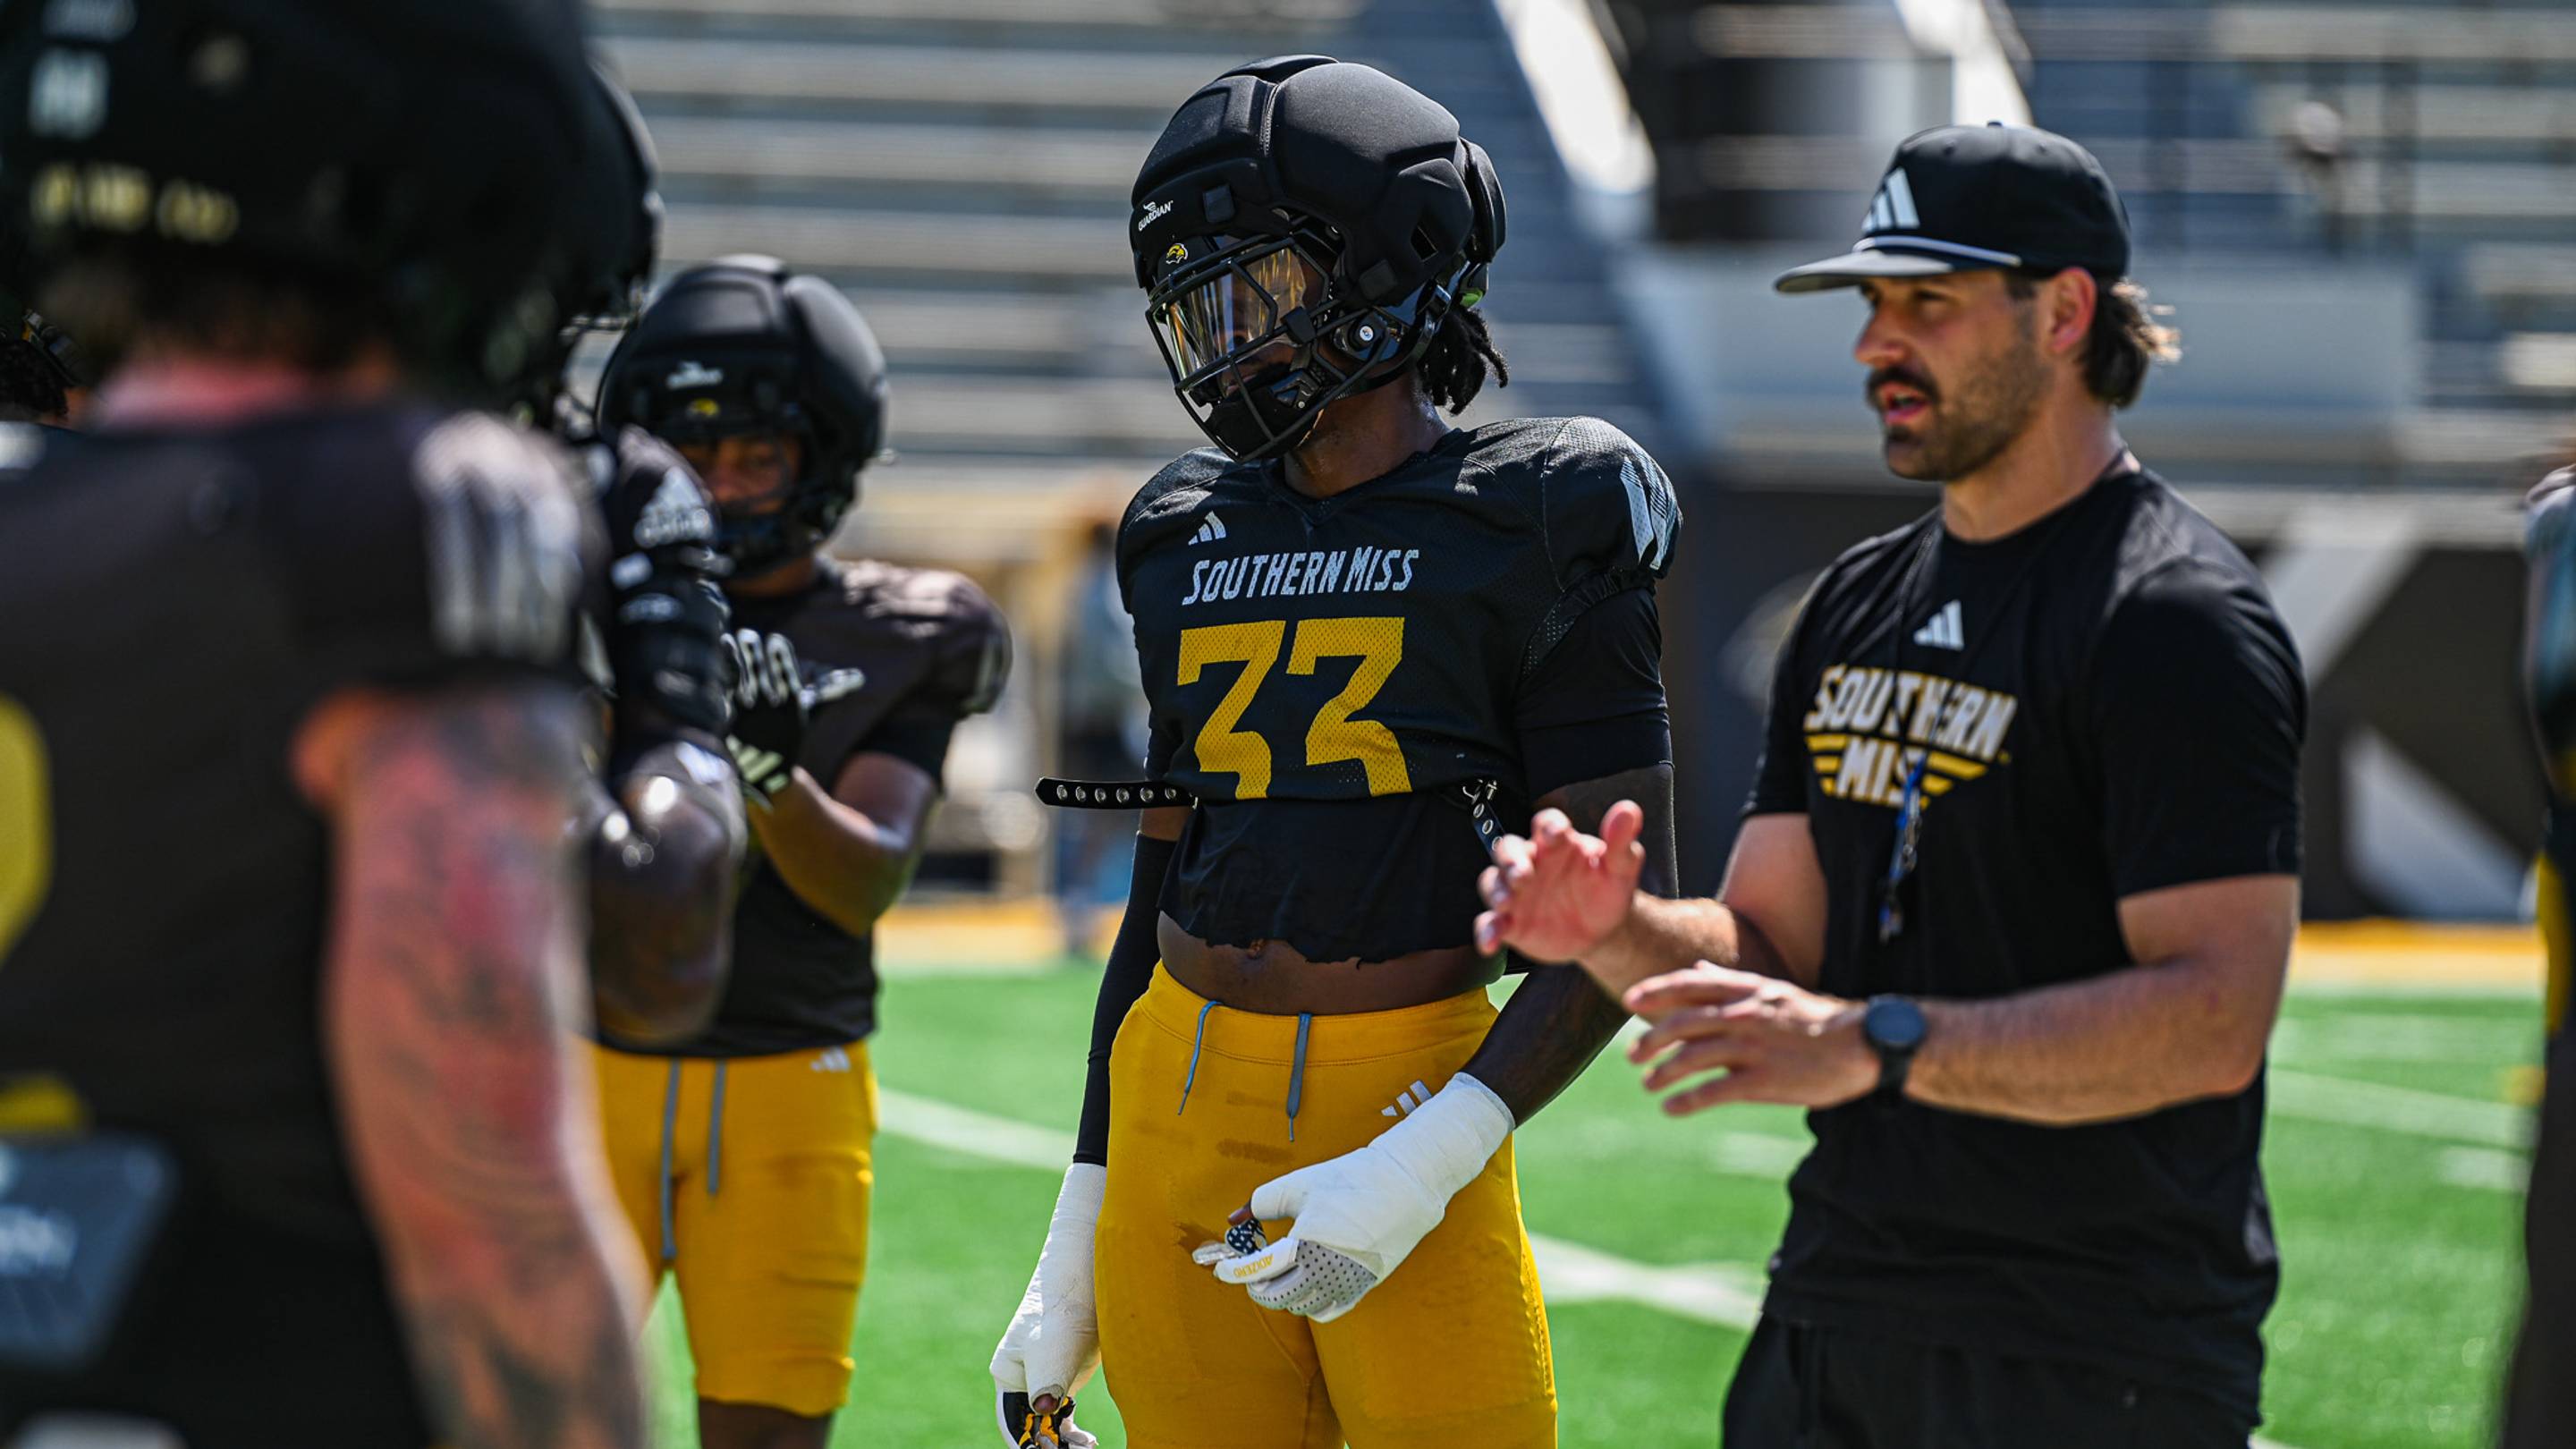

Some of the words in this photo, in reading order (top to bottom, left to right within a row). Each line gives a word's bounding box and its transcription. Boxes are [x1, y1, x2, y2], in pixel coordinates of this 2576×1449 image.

[1182, 550, 1346, 606] SOUTHERN
[1343, 546, 1419, 593] MISS
[1803, 665, 2018, 761] SOUTHERN
